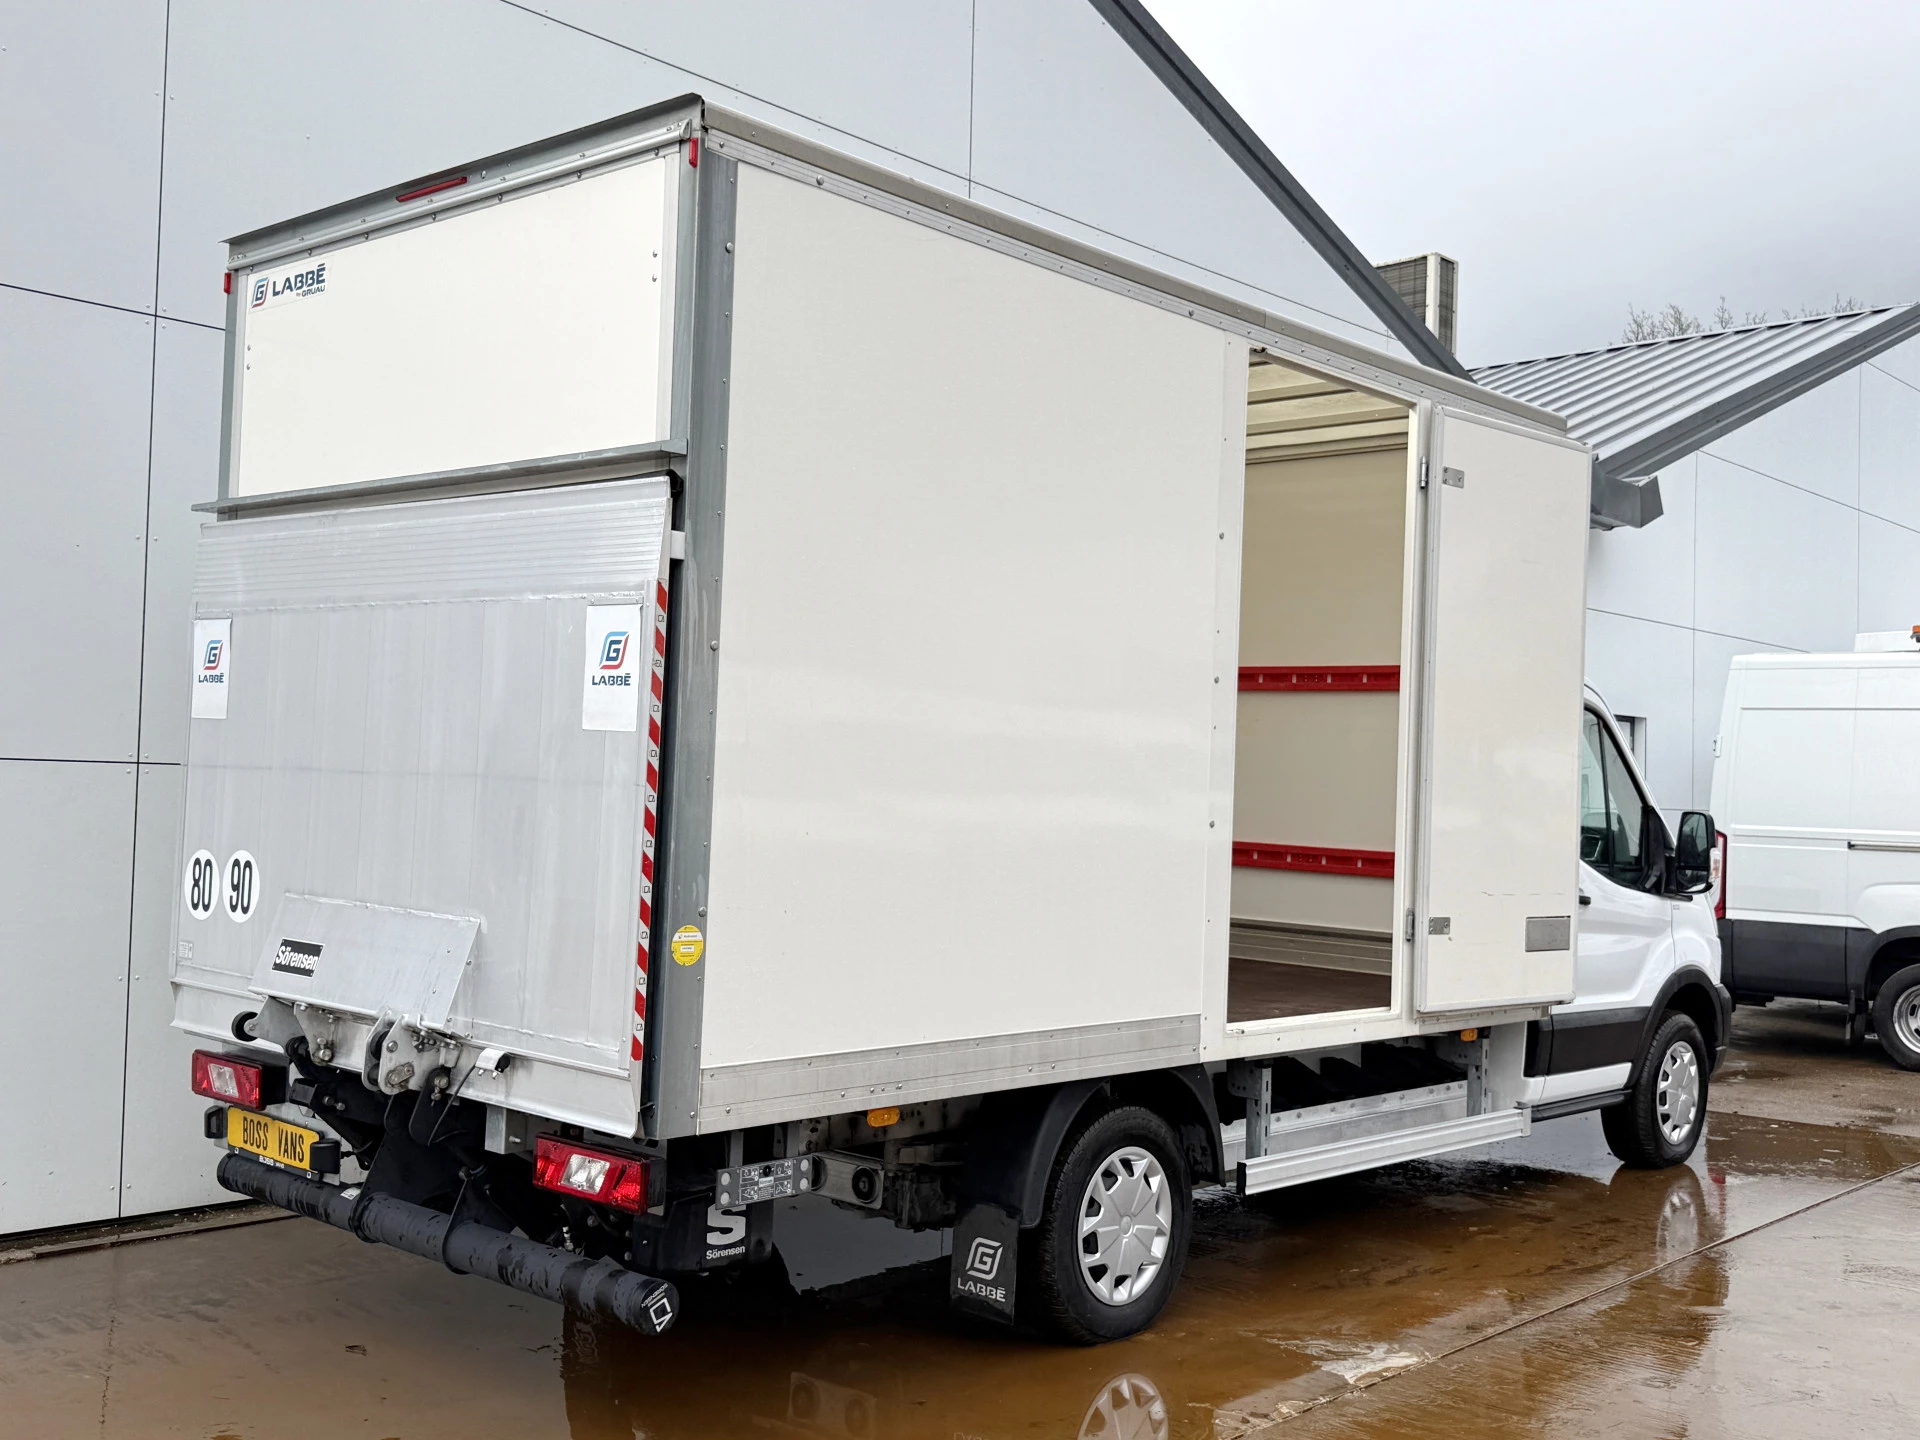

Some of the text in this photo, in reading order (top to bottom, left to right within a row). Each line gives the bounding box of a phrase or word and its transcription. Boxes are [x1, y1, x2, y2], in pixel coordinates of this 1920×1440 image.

[272, 263, 326, 297] LABBÉ
[301, 285, 326, 297] GRUAU
[191, 857, 213, 913] 80
[229, 858, 253, 915] 90
[275, 945, 319, 971] Sörensen
[242, 1116, 305, 1164] BOSS VANS
[706, 1245, 746, 1260] Sörensen
